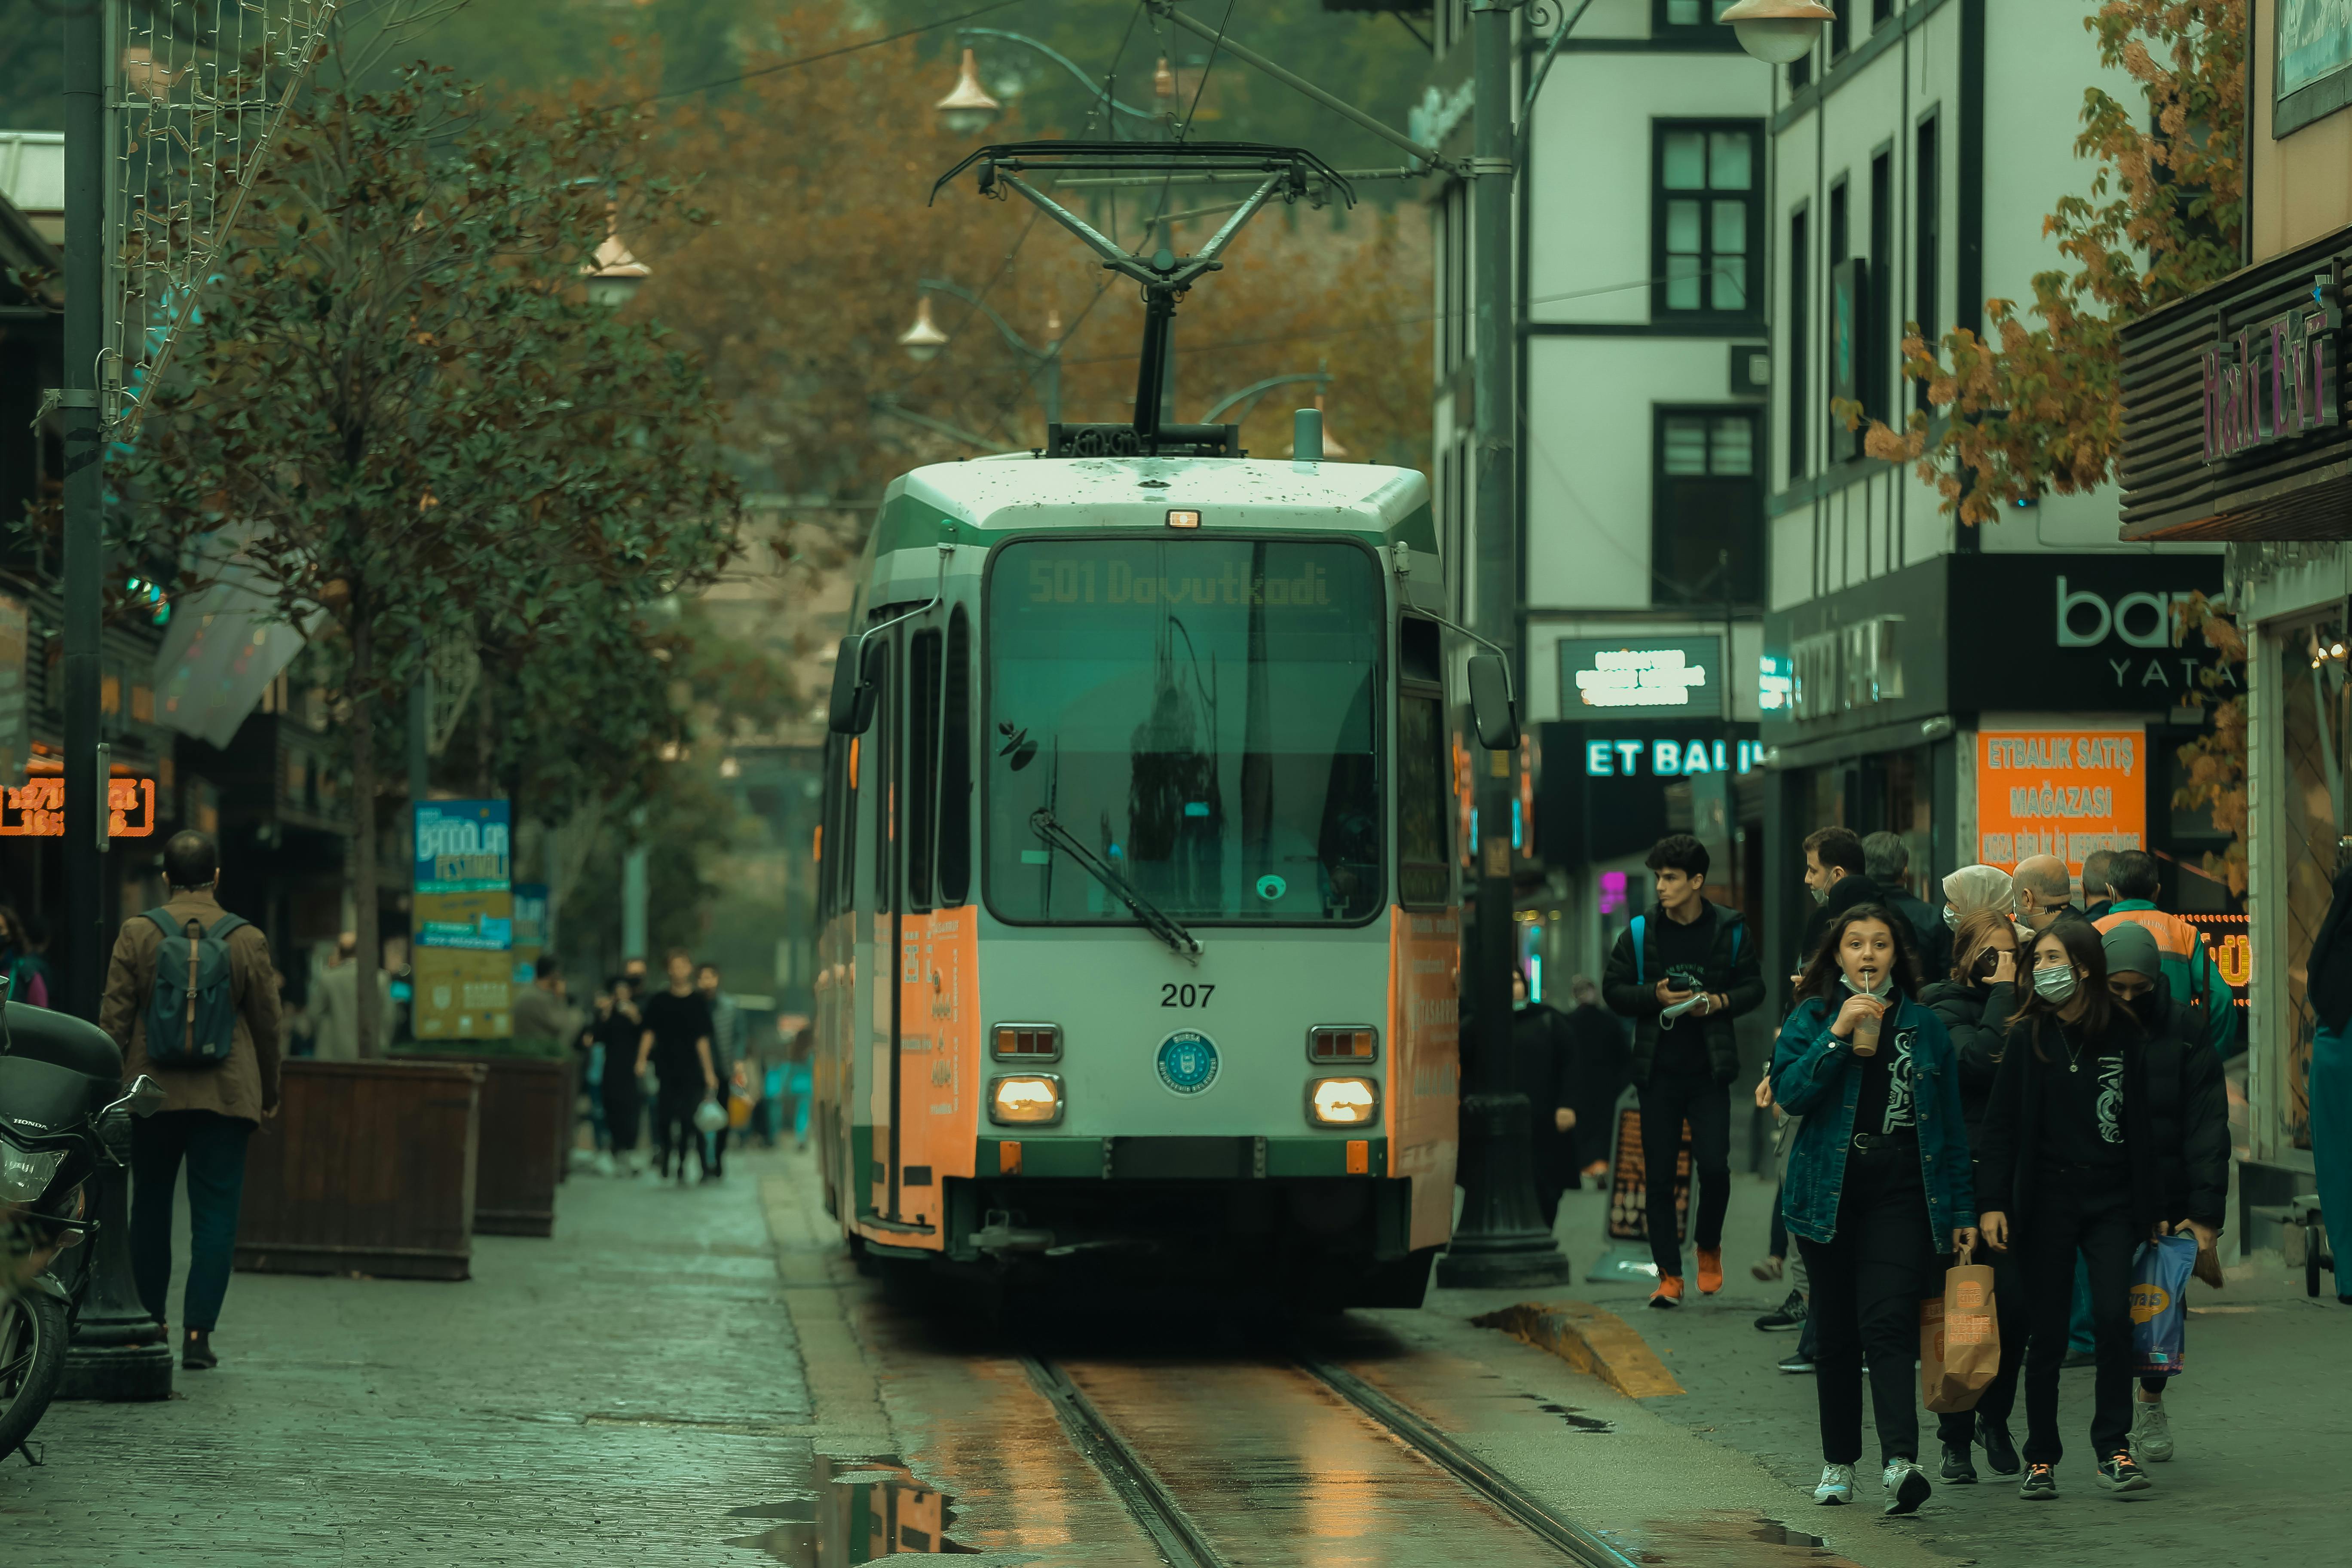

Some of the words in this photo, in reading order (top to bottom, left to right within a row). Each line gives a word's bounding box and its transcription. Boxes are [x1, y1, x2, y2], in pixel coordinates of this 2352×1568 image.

[1029, 560, 1095, 602] 501
[1586, 739, 1644, 776] ET
[1988, 737, 2073, 769] ETBALIK
[2076, 737, 2135, 777] SATIŞ
[2009, 779, 2112, 818] MAĞAZASI
[1161, 983, 1216, 1008] 207
[13, 1118, 49, 1130] HONDA
